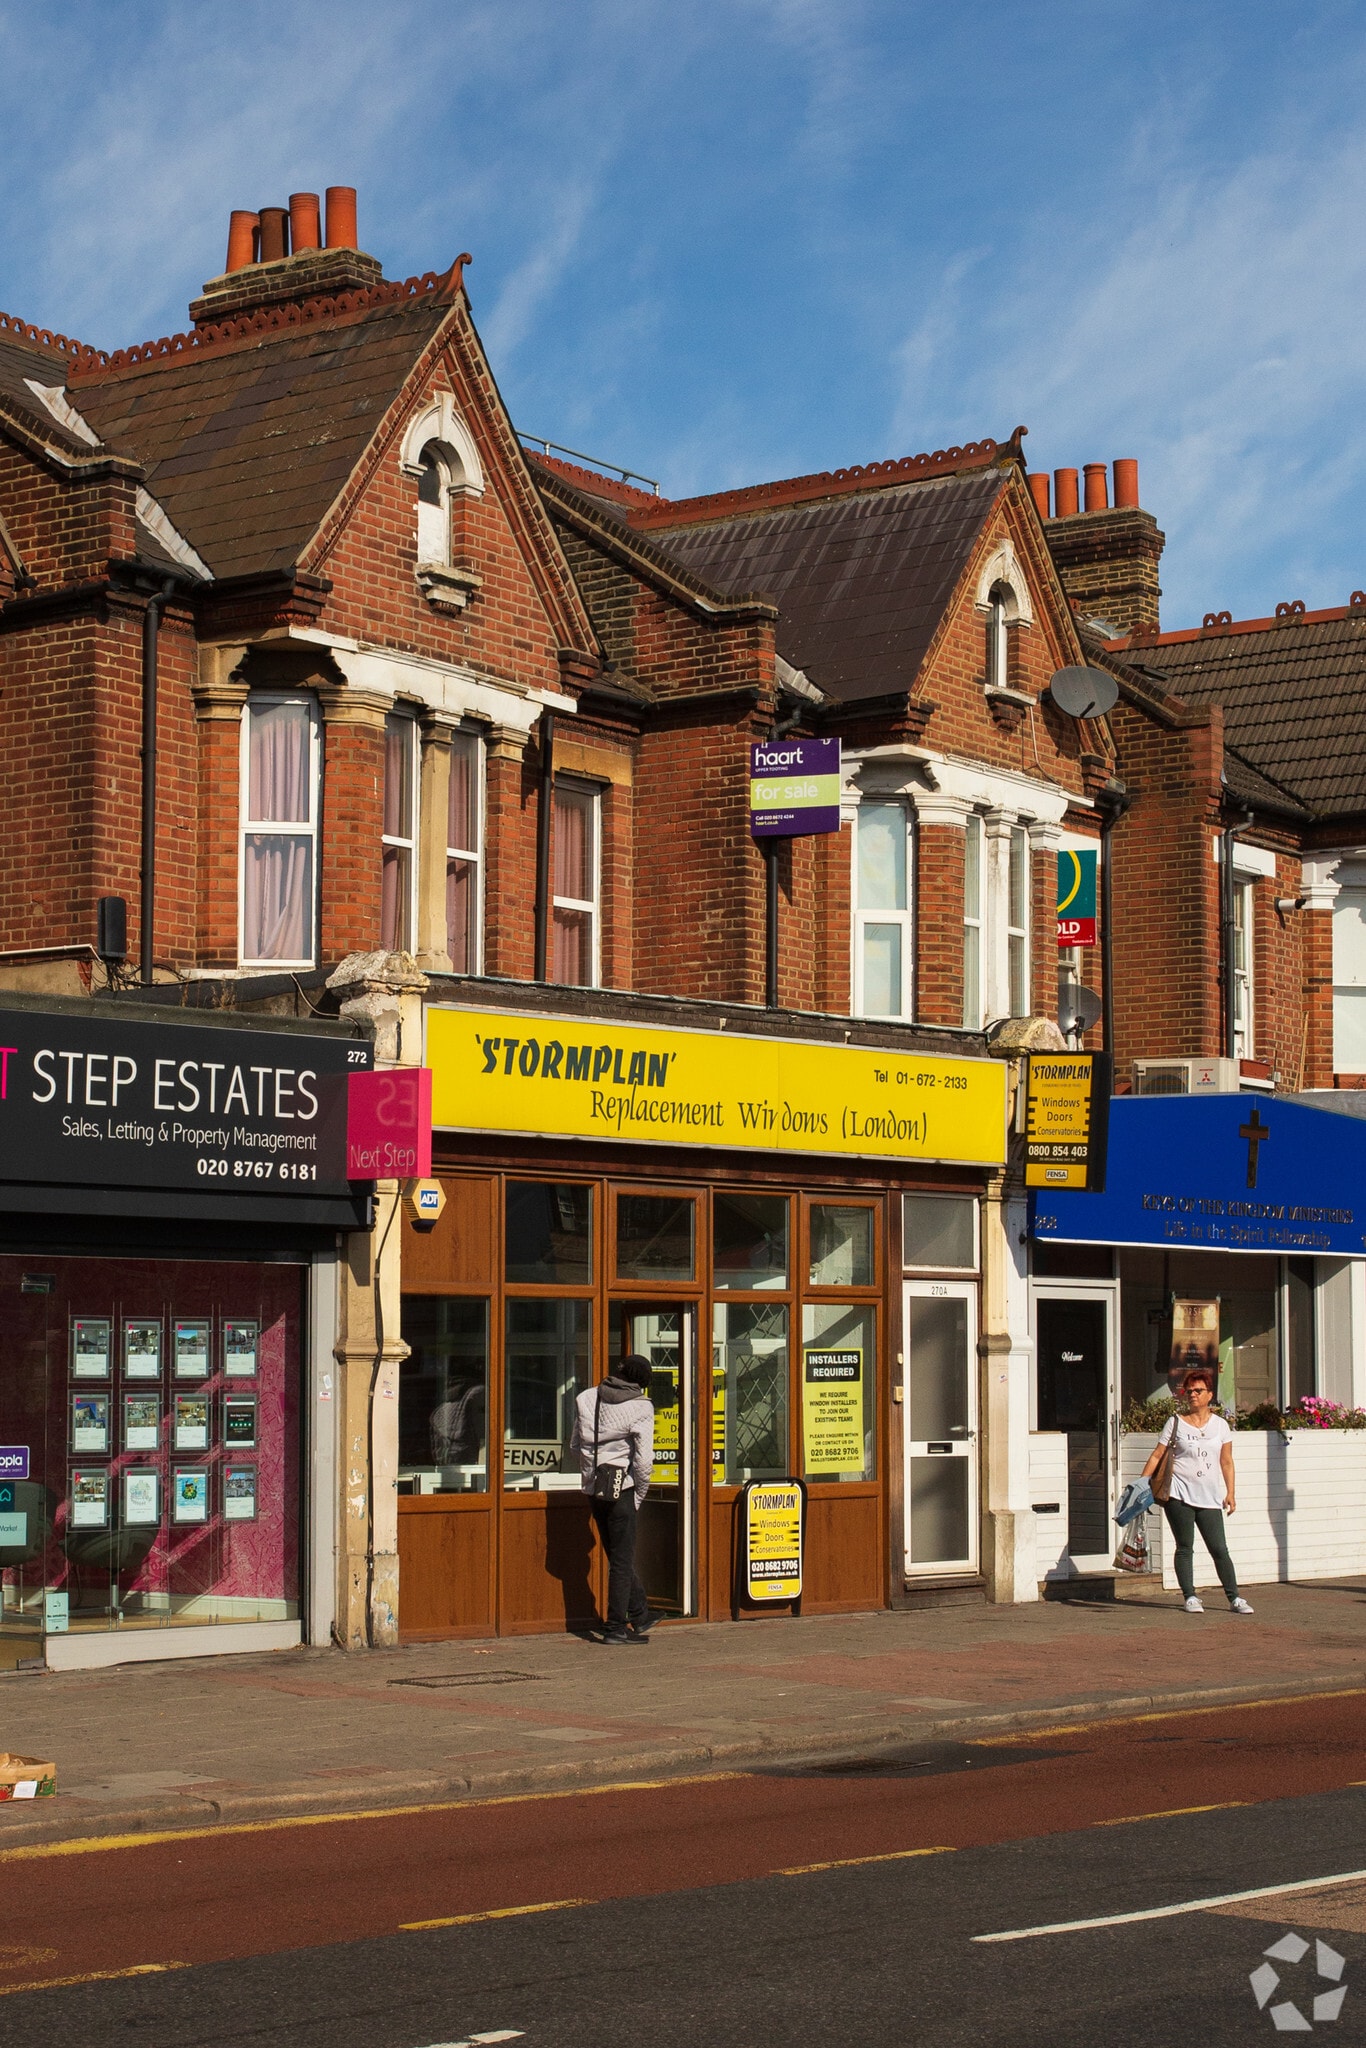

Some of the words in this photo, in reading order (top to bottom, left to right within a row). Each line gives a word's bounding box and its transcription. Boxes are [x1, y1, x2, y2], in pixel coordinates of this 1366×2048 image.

[755, 747, 804, 766] haart
[755, 783, 781, 800] for
[784, 781, 818, 799] sale
[347, 1051, 367, 1064] 272
[874, 1069, 888, 1083] Tel
[32, 1049, 138, 1107] STEP
[154, 1059, 319, 1120] ESTATES
[1042, 1097, 1080, 1108] Windows
[590, 1080, 724, 1131] Replacement
[842, 1106, 927, 1144] (London)
[1047, 1112, 1073, 1121] Doors
[62, 1115, 103, 1141] Sales,
[108, 1119, 154, 1146] Letting
[158, 1121, 169, 1142] &
[173, 1122, 230, 1151] Property
[233, 1126, 317, 1153] Management
[1037, 1126, 1082, 1136] Conservatories
[350, 1145, 380, 1168] Next
[384, 1142, 416, 1173] Step
[1028, 1145, 1050, 1156] 0800
[1052, 1145, 1069, 1156] 854
[1071, 1146, 1088, 1157] 403
[197, 1159, 228, 1175] 020
[233, 1161, 274, 1178] 8767
[279, 1163, 317, 1181] 6181
[420, 1192, 439, 1205] ADT
[1142, 1194, 1176, 1211] KEYS
[1178, 1198, 1196, 1212] OF
[1199, 1199, 1224, 1215] THE
[1227, 1201, 1285, 1220] KINGDOM
[1288, 1206, 1354, 1224] MINISTRIES
[1164, 1221, 1187, 1237] Life
[1192, 1222, 1203, 1238] in
[1207, 1223, 1226, 1239] the
[1230, 1225, 1264, 1245] Spirit
[1268, 1228, 1331, 1250] Fellowship
[931, 1286, 948, 1296] 270A
[808, 1354, 859, 1365] INSTALLERS
[1061, 1351, 1084, 1362] Welcome
[813, 1367, 855, 1377] REQUIRED
[811, 1448, 824, 1457] 020
[825, 1447, 841, 1456] 8682
[843, 1447, 859, 1456] 9706
[613, 1469, 623, 1499] adidas
[760, 1519, 790, 1529] Windows
[765, 1533, 785, 1542] Doors
[755, 1545, 794, 1554] Conservatories
[751, 1561, 764, 1572] 020
[765, 1560, 781, 1571] 8682
[781, 1559, 798, 1570] 9706
